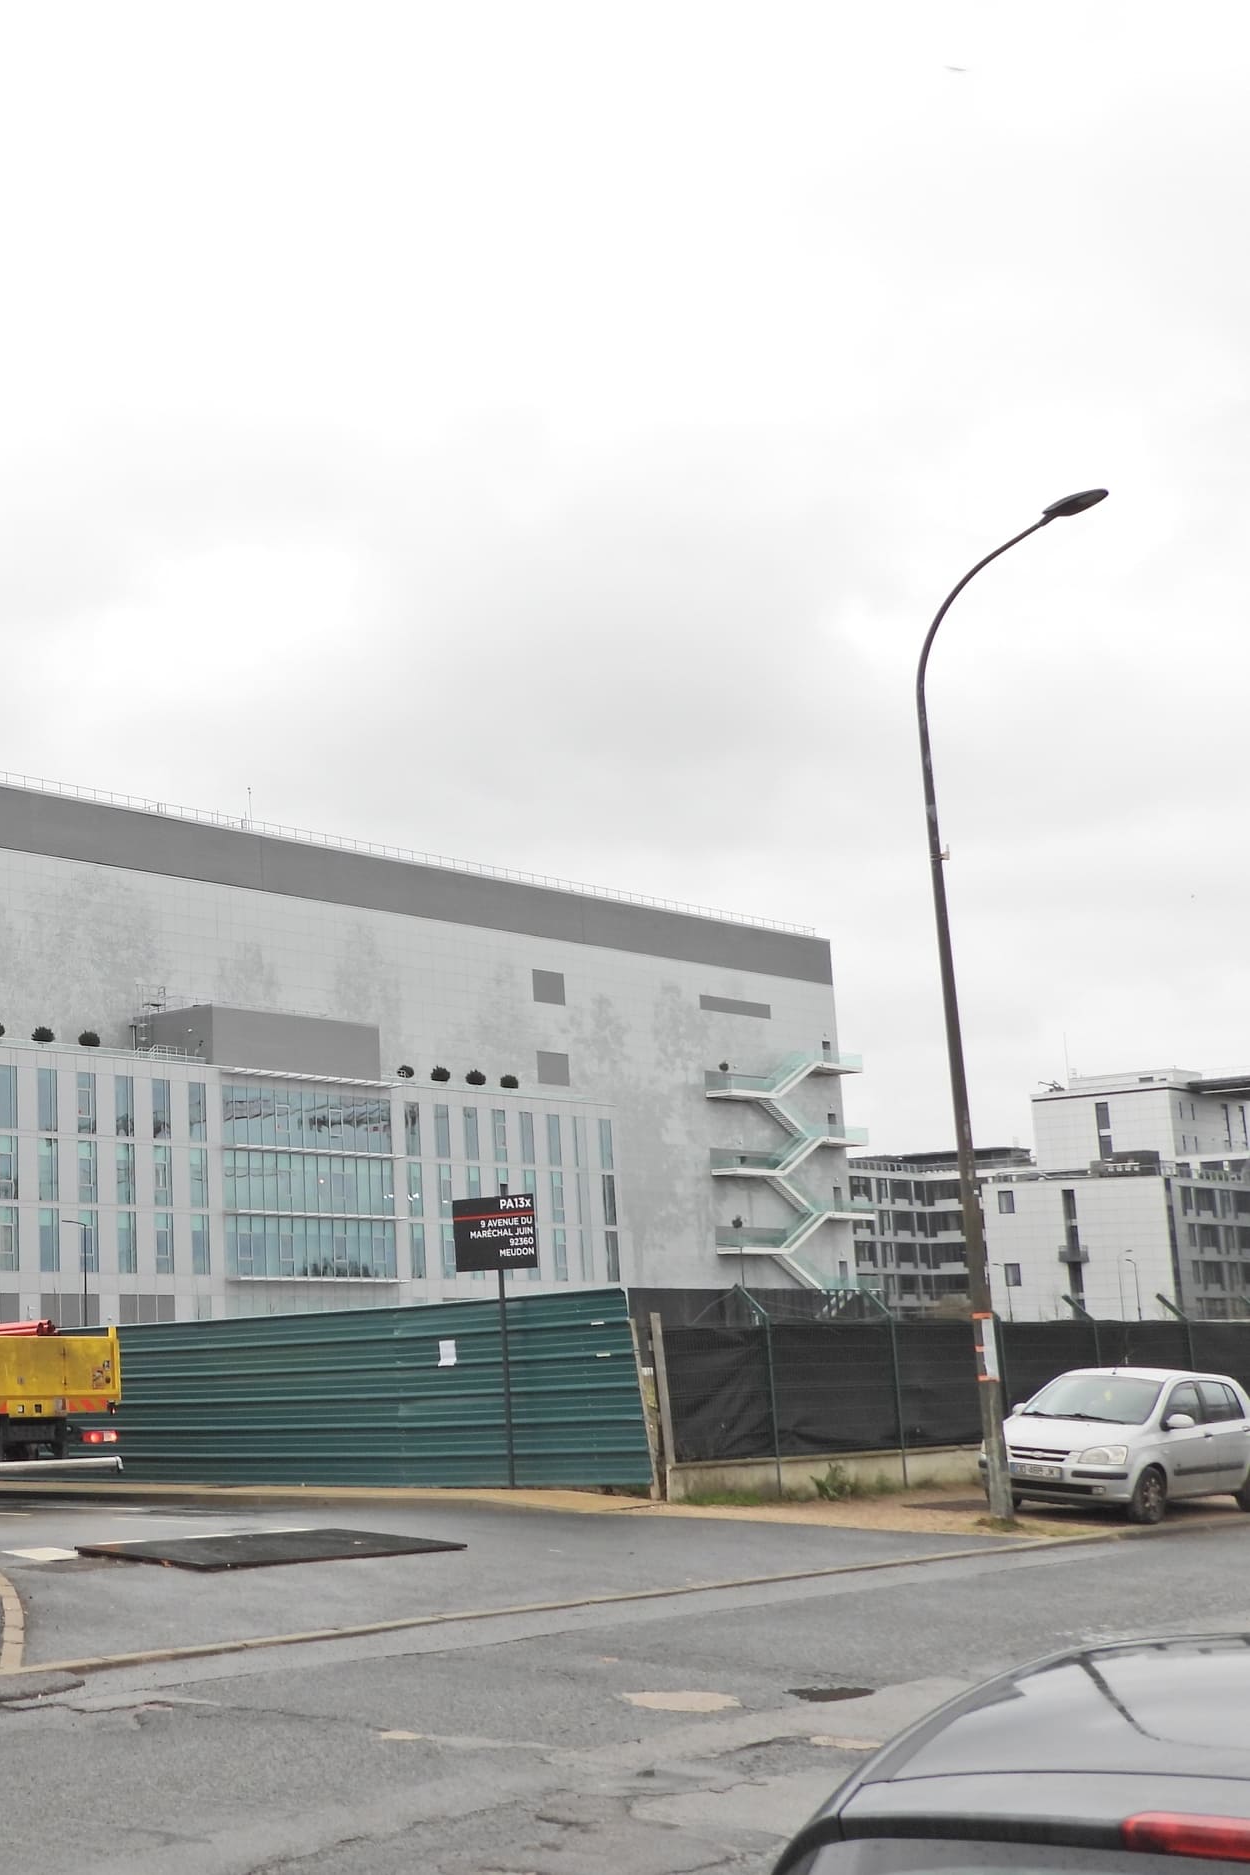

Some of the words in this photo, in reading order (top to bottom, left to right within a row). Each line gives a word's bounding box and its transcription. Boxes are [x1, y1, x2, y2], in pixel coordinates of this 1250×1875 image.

[500, 1197, 532, 1209] PA13x
[480, 1220, 486, 1228] 9
[487, 1217, 519, 1228] AVENUE
[520, 1216, 533, 1225] DU
[470, 1228, 514, 1239] MARÉCHAL
[515, 1226, 533, 1236] JUIN
[509, 1236, 534, 1246] 92360
[500, 1247, 535, 1257] MEUDON
